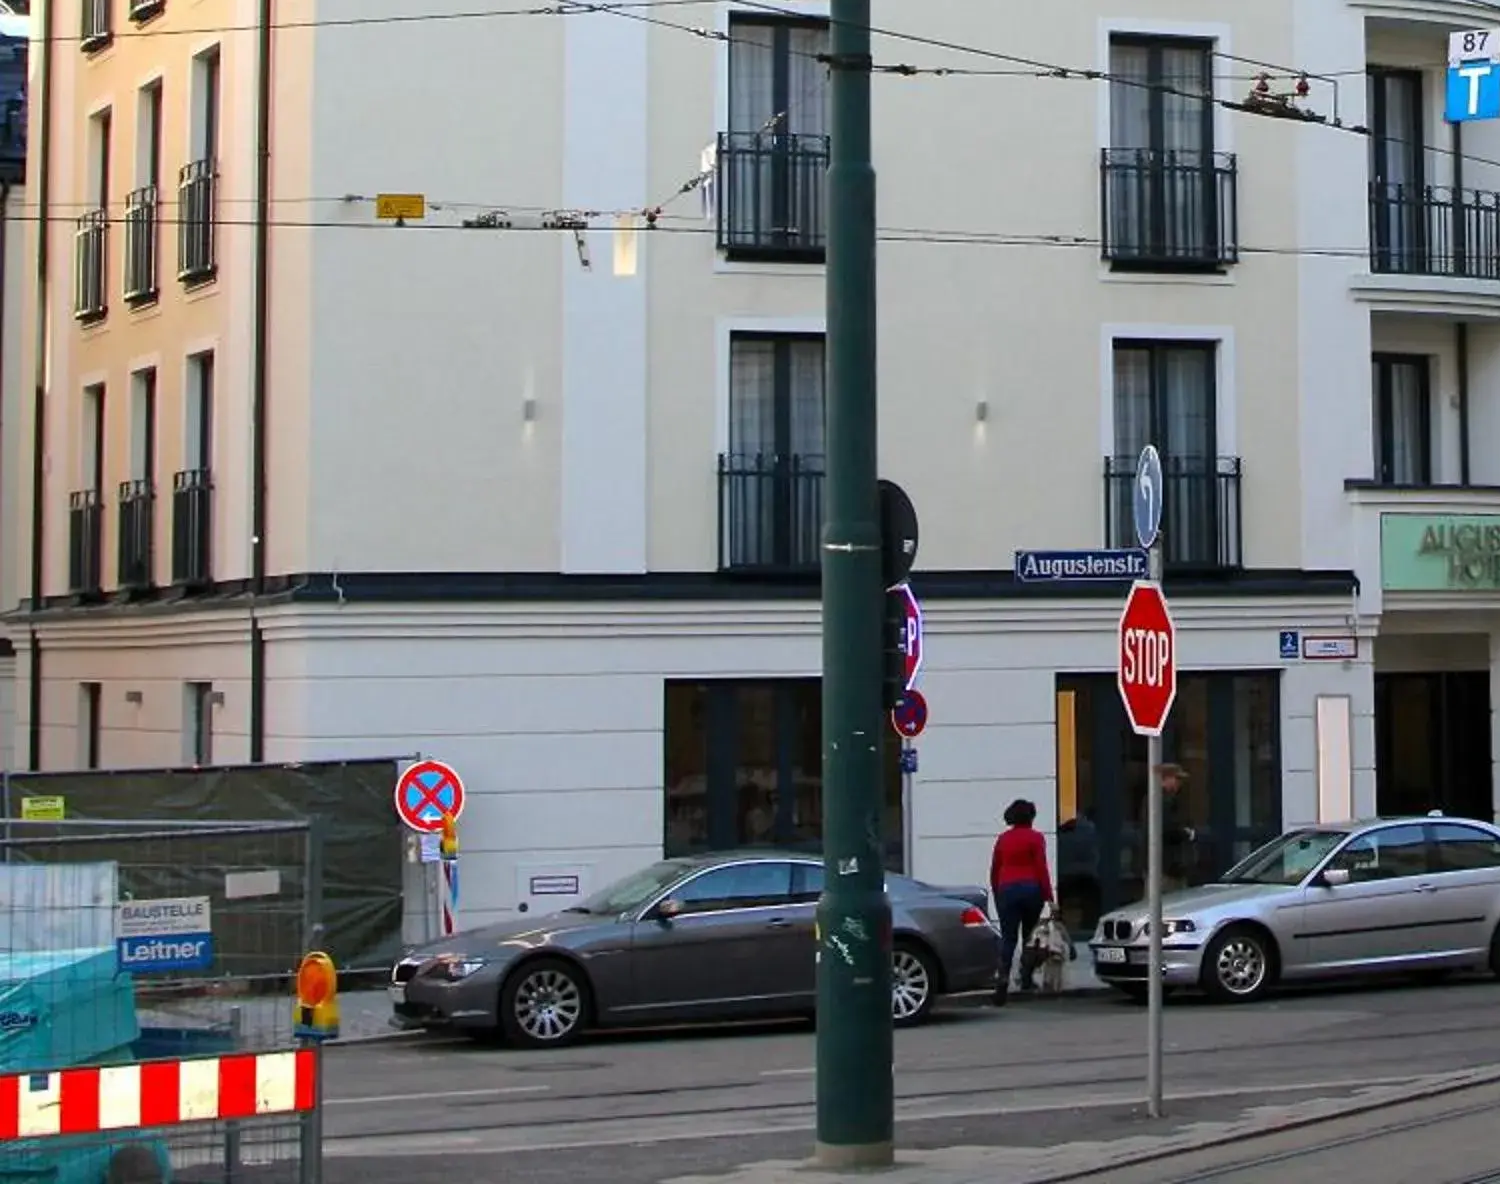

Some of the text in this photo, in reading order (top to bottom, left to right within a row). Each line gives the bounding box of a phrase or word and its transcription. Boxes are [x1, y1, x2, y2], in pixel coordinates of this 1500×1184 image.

[1463, 31, 1490, 53] 87
[1458, 65, 1491, 115] T
[1124, 627, 1169, 687] STOP
[121, 902, 204, 920] BAUSTELLE
[121, 940, 205, 963] Leitner
